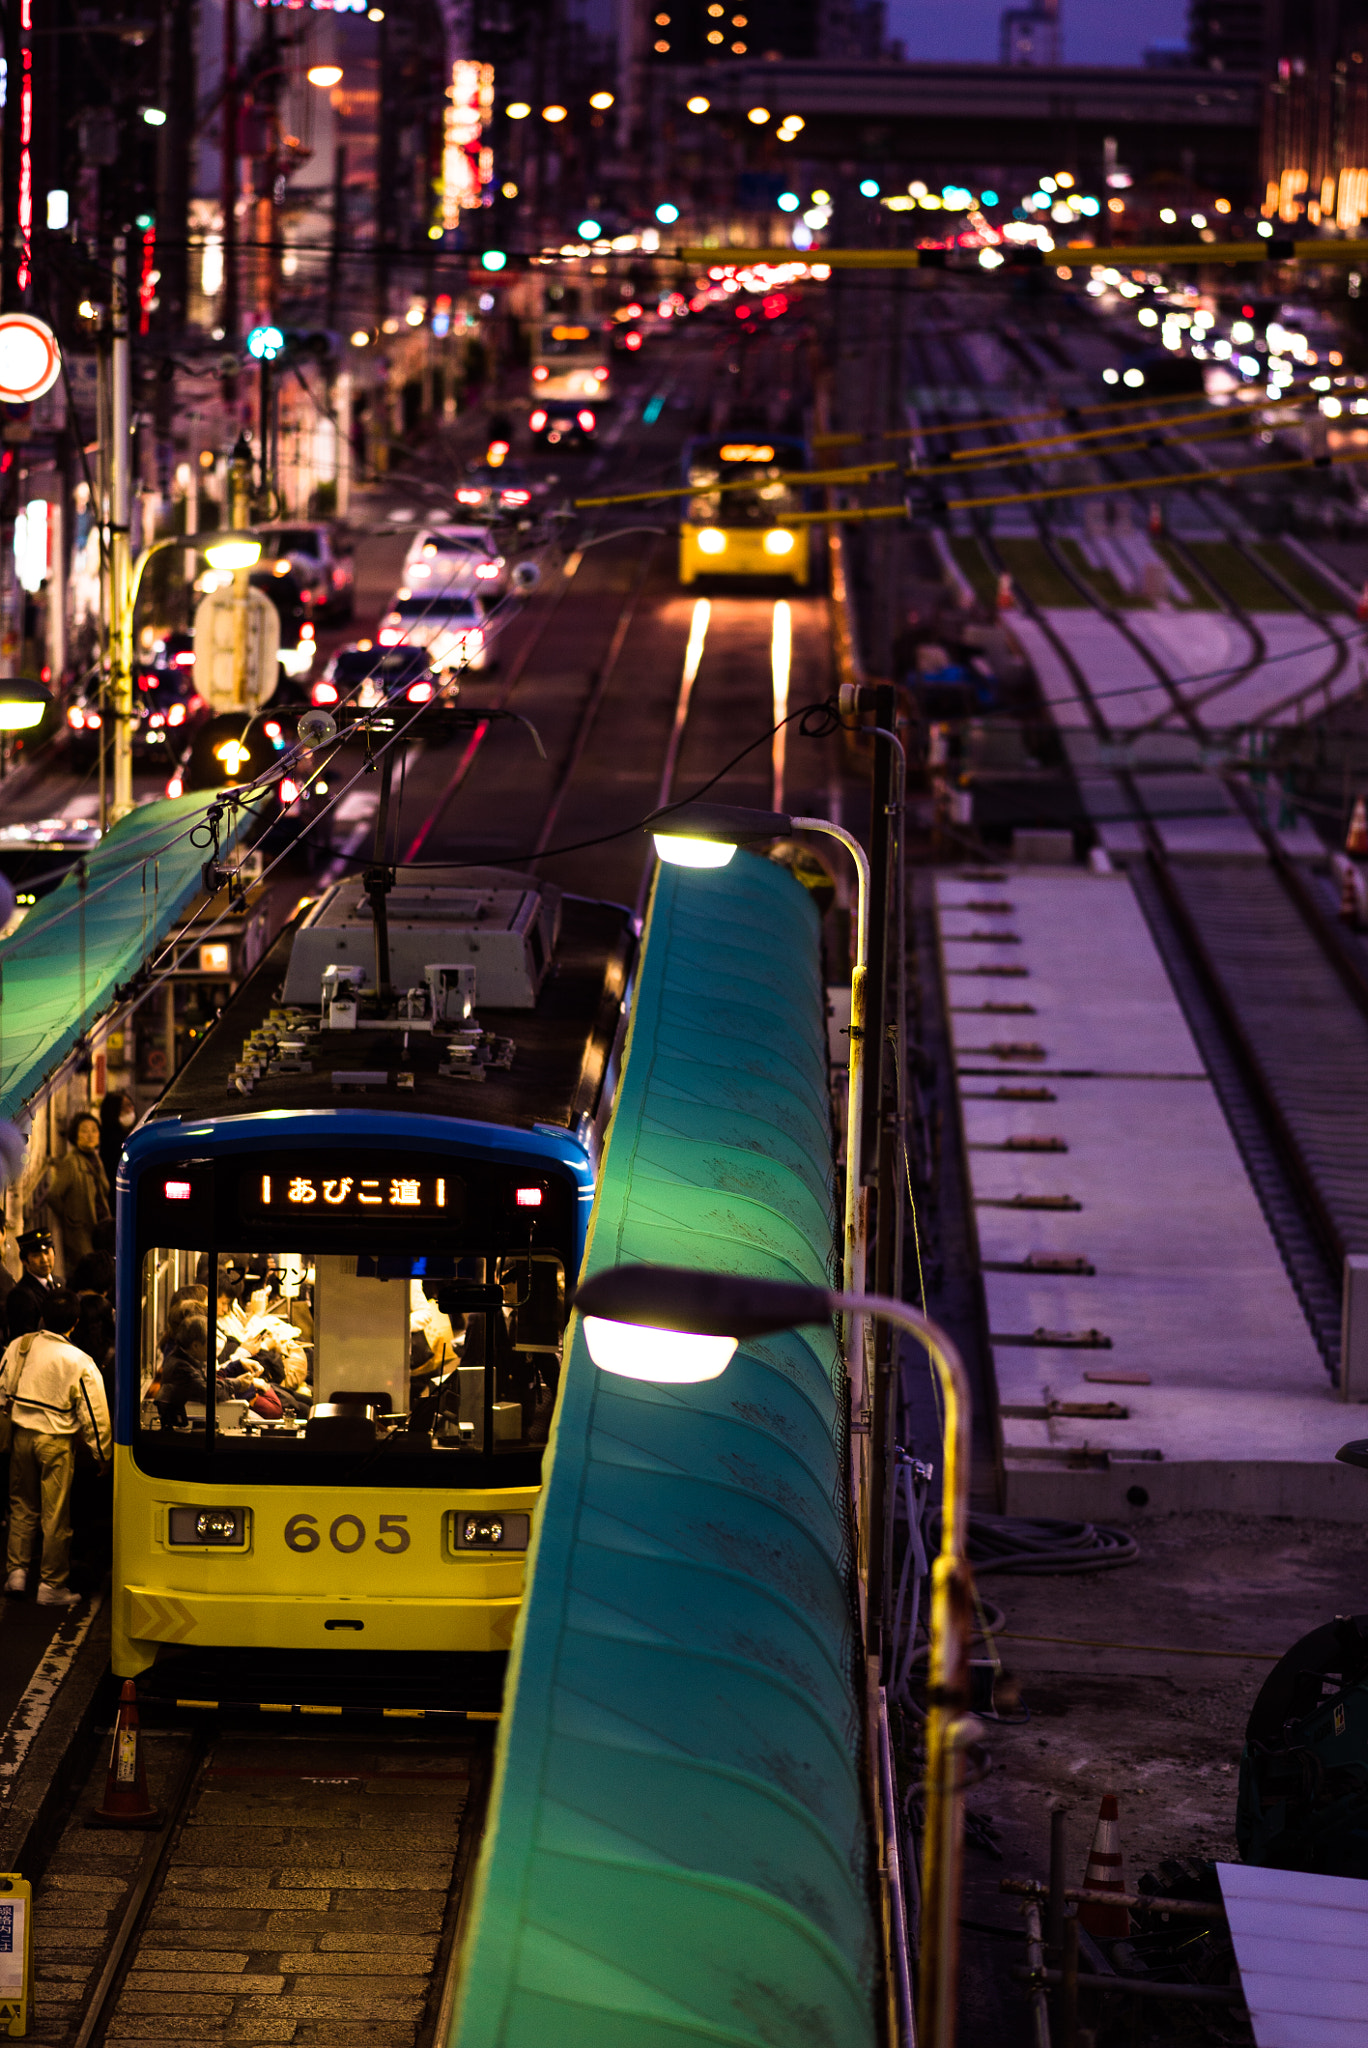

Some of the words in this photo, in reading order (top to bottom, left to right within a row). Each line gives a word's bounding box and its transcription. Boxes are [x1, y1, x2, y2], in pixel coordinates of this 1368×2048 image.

[288, 1177, 421, 1206] あびこ道
[284, 1514, 410, 1554] 605
